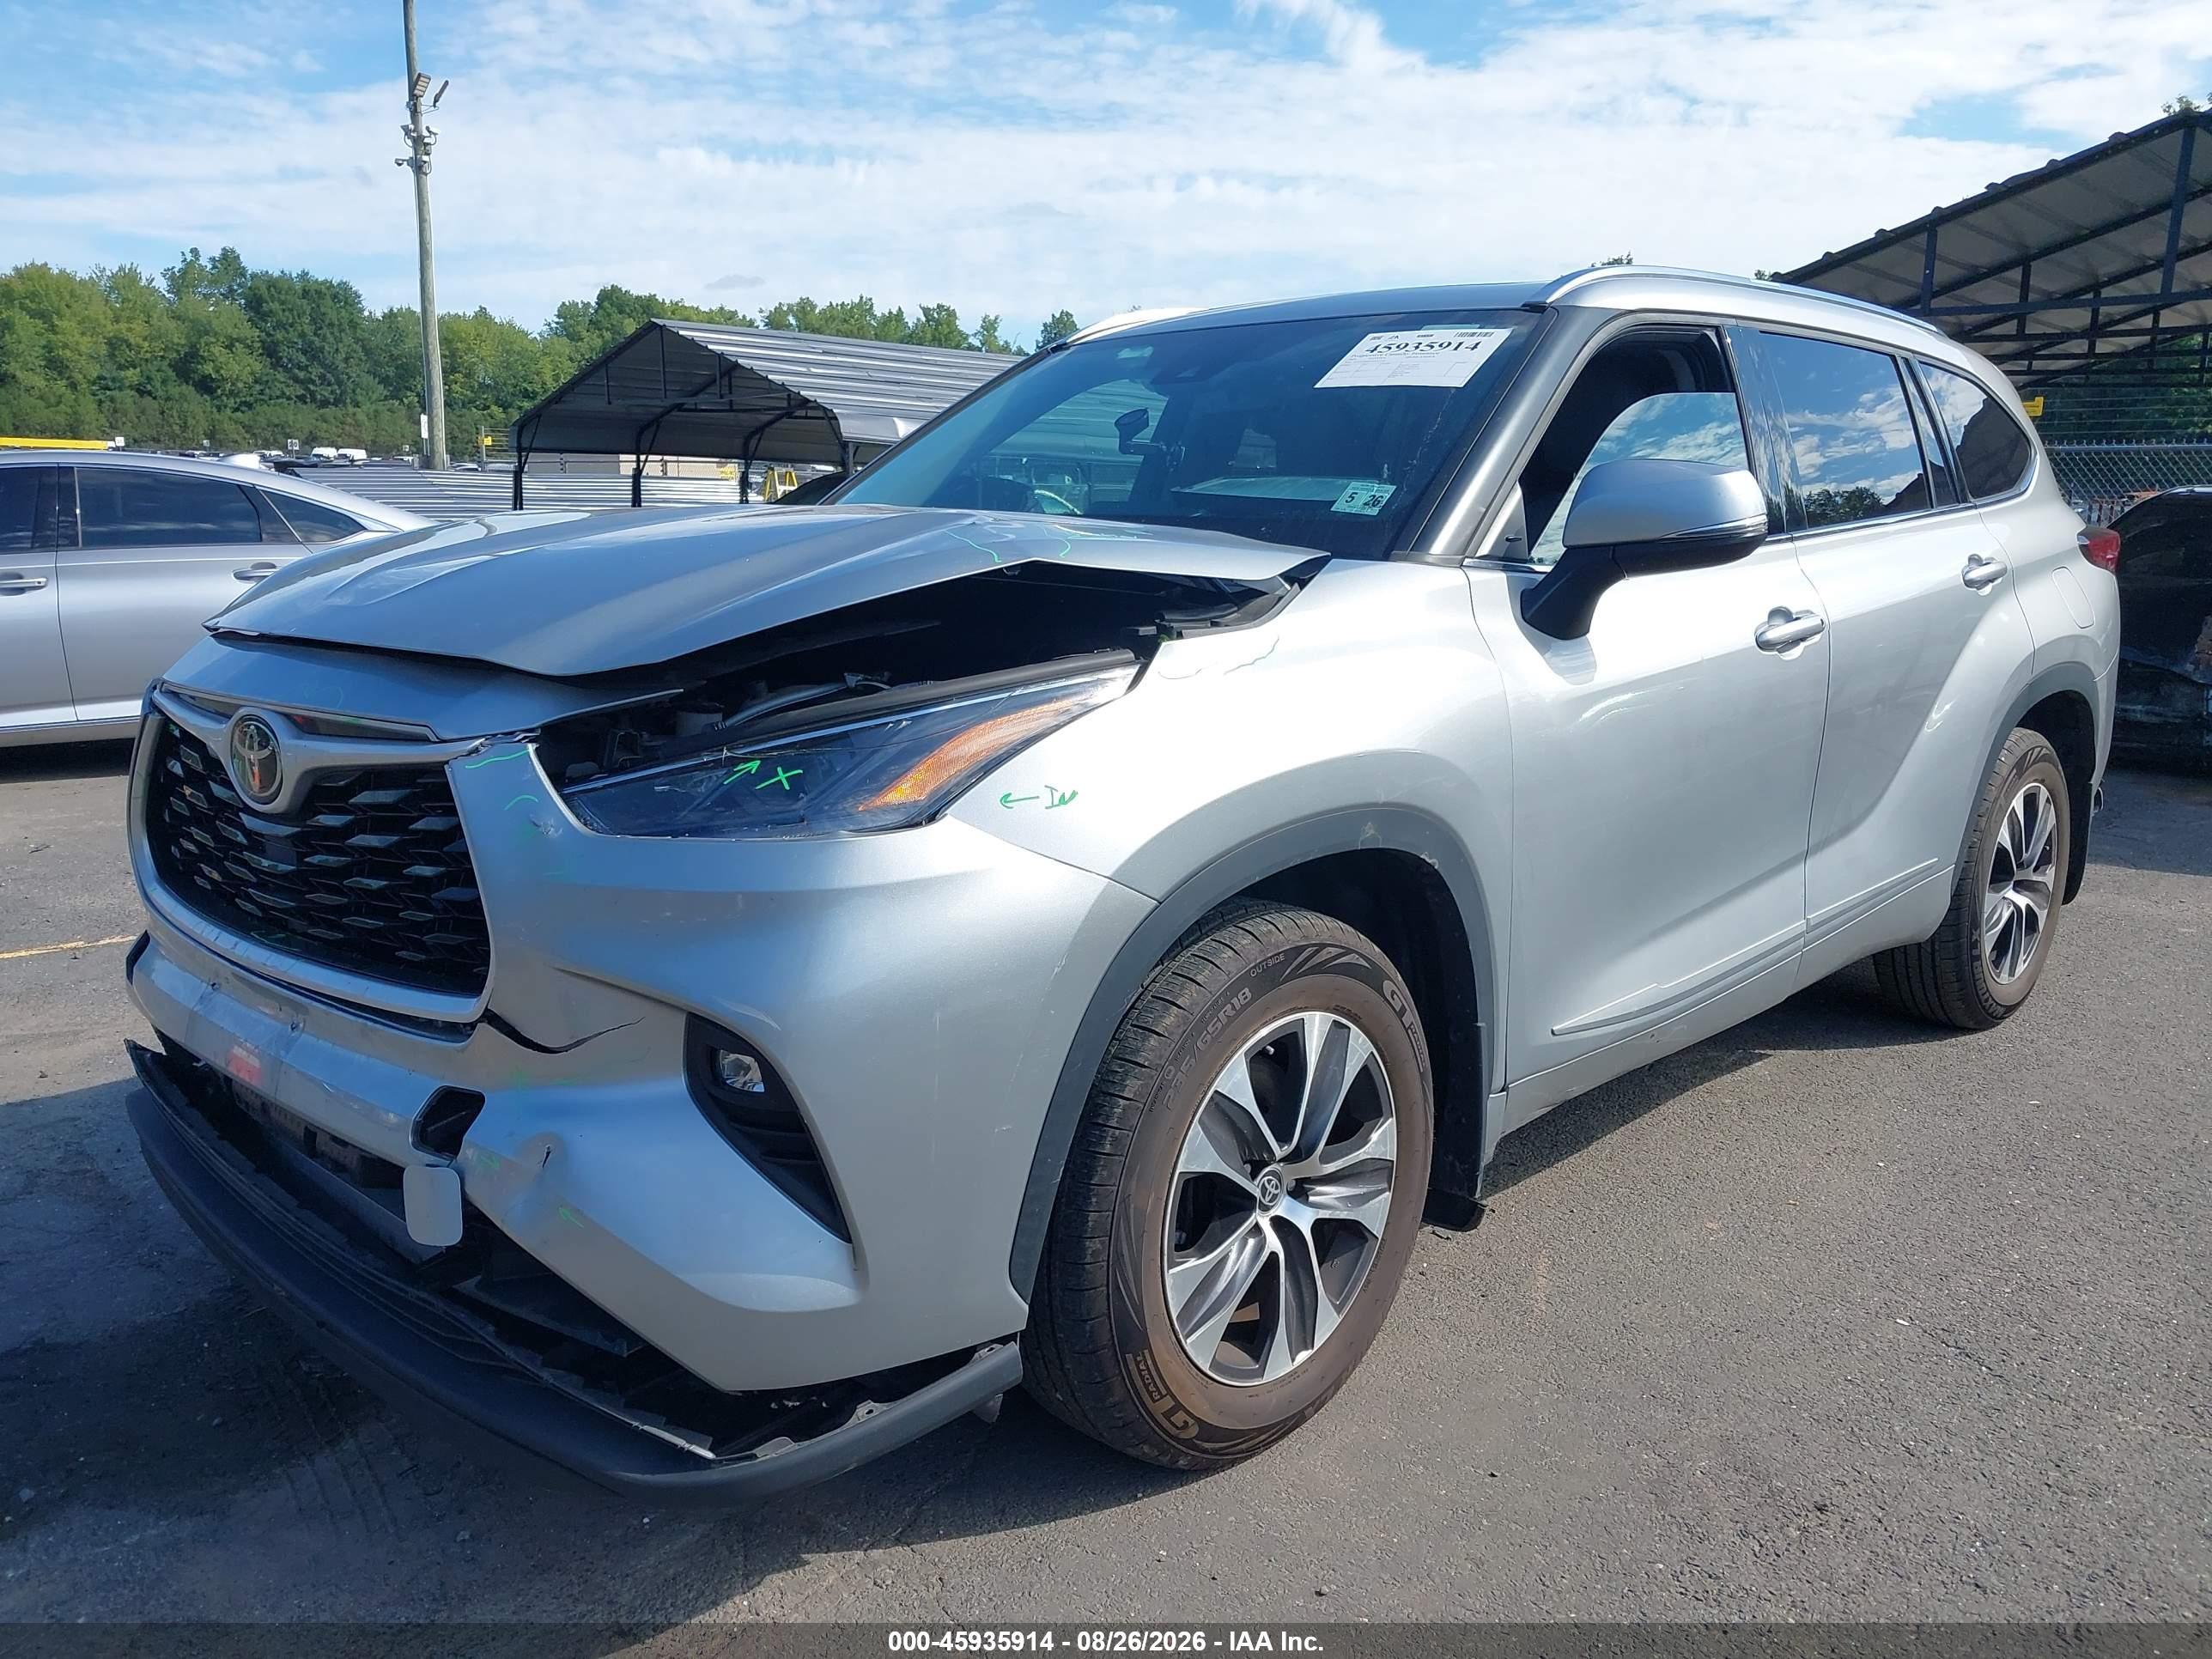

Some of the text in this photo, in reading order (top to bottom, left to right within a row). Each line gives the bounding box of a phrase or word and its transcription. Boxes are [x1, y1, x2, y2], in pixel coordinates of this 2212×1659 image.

[1364, 341, 1482, 354] 45935914
[1345, 492, 1384, 507] 5 26
[1249, 953, 1285, 977] OUTSIDE
[1162, 988, 1252, 1111] 235/65R18
[1136, 1351, 1160, 1401] RADIAL
